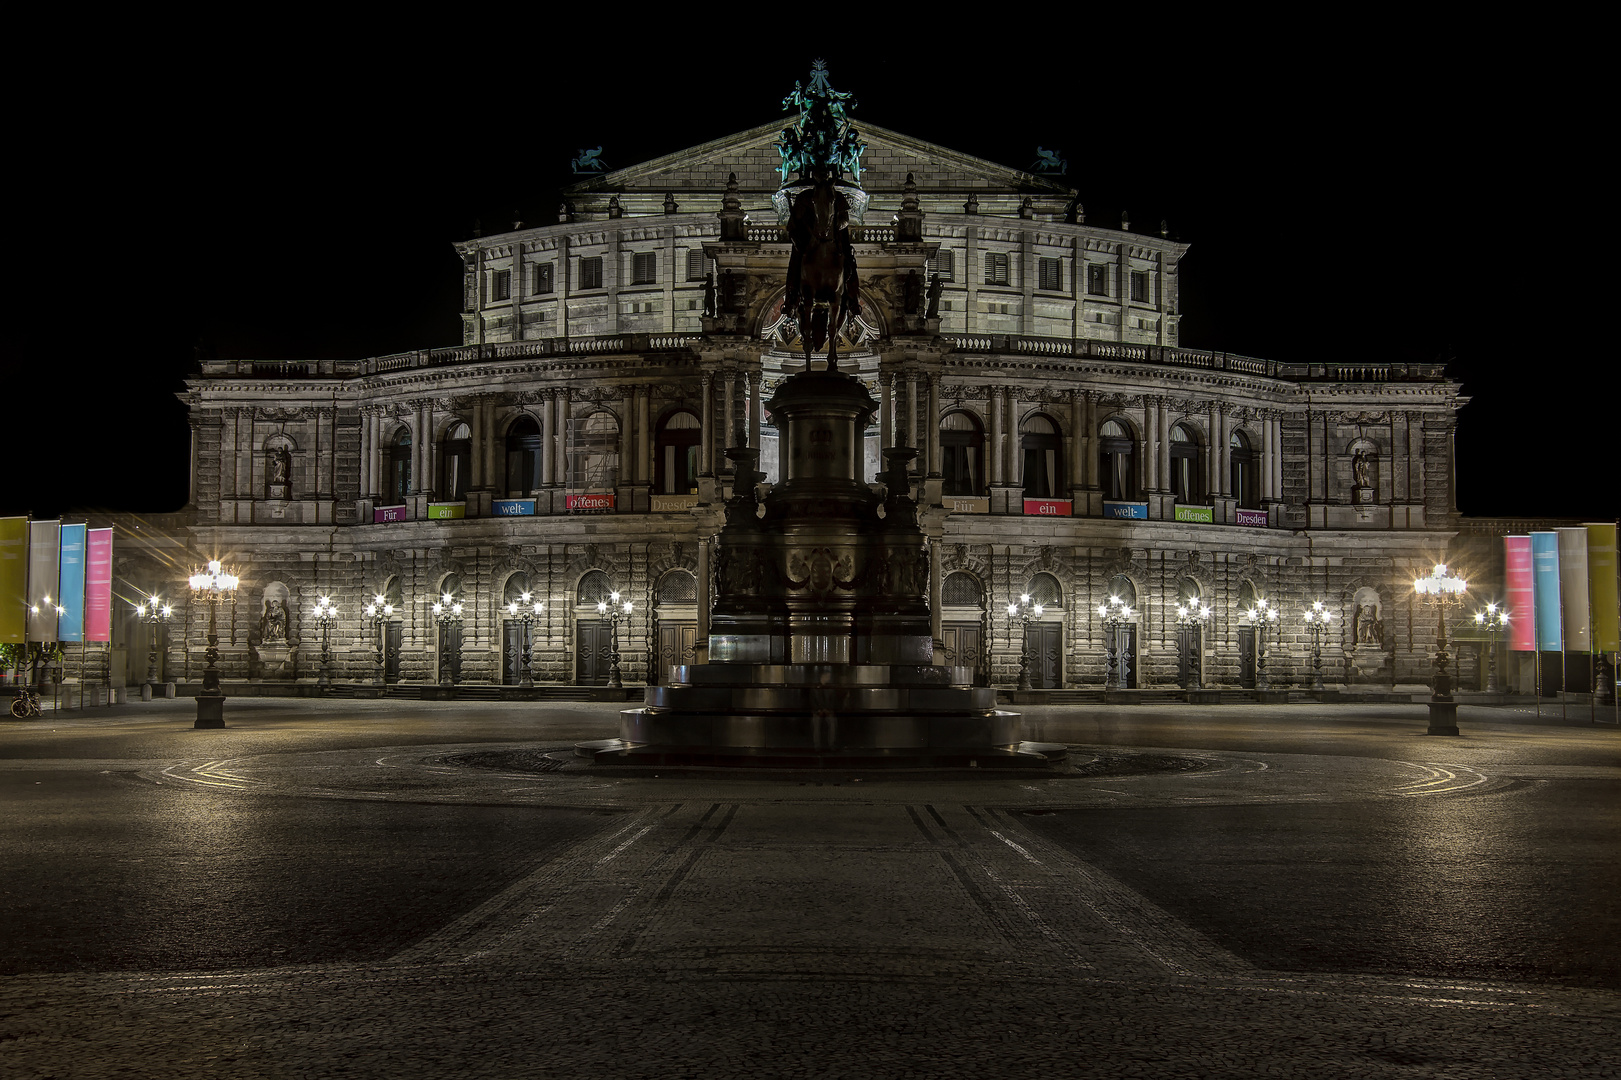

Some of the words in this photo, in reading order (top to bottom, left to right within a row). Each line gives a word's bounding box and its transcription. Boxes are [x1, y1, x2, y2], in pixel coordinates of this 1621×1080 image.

[570, 497, 610, 508] offenes
[953, 500, 975, 513] Für
[439, 507, 453, 518] ein
[501, 503, 525, 514] welt-
[1039, 503, 1057, 514] ein
[1113, 506, 1138, 517] welt-
[383, 509, 398, 521] Für
[1178, 509, 1210, 521] offenes
[1236, 512, 1267, 525] Dresden
